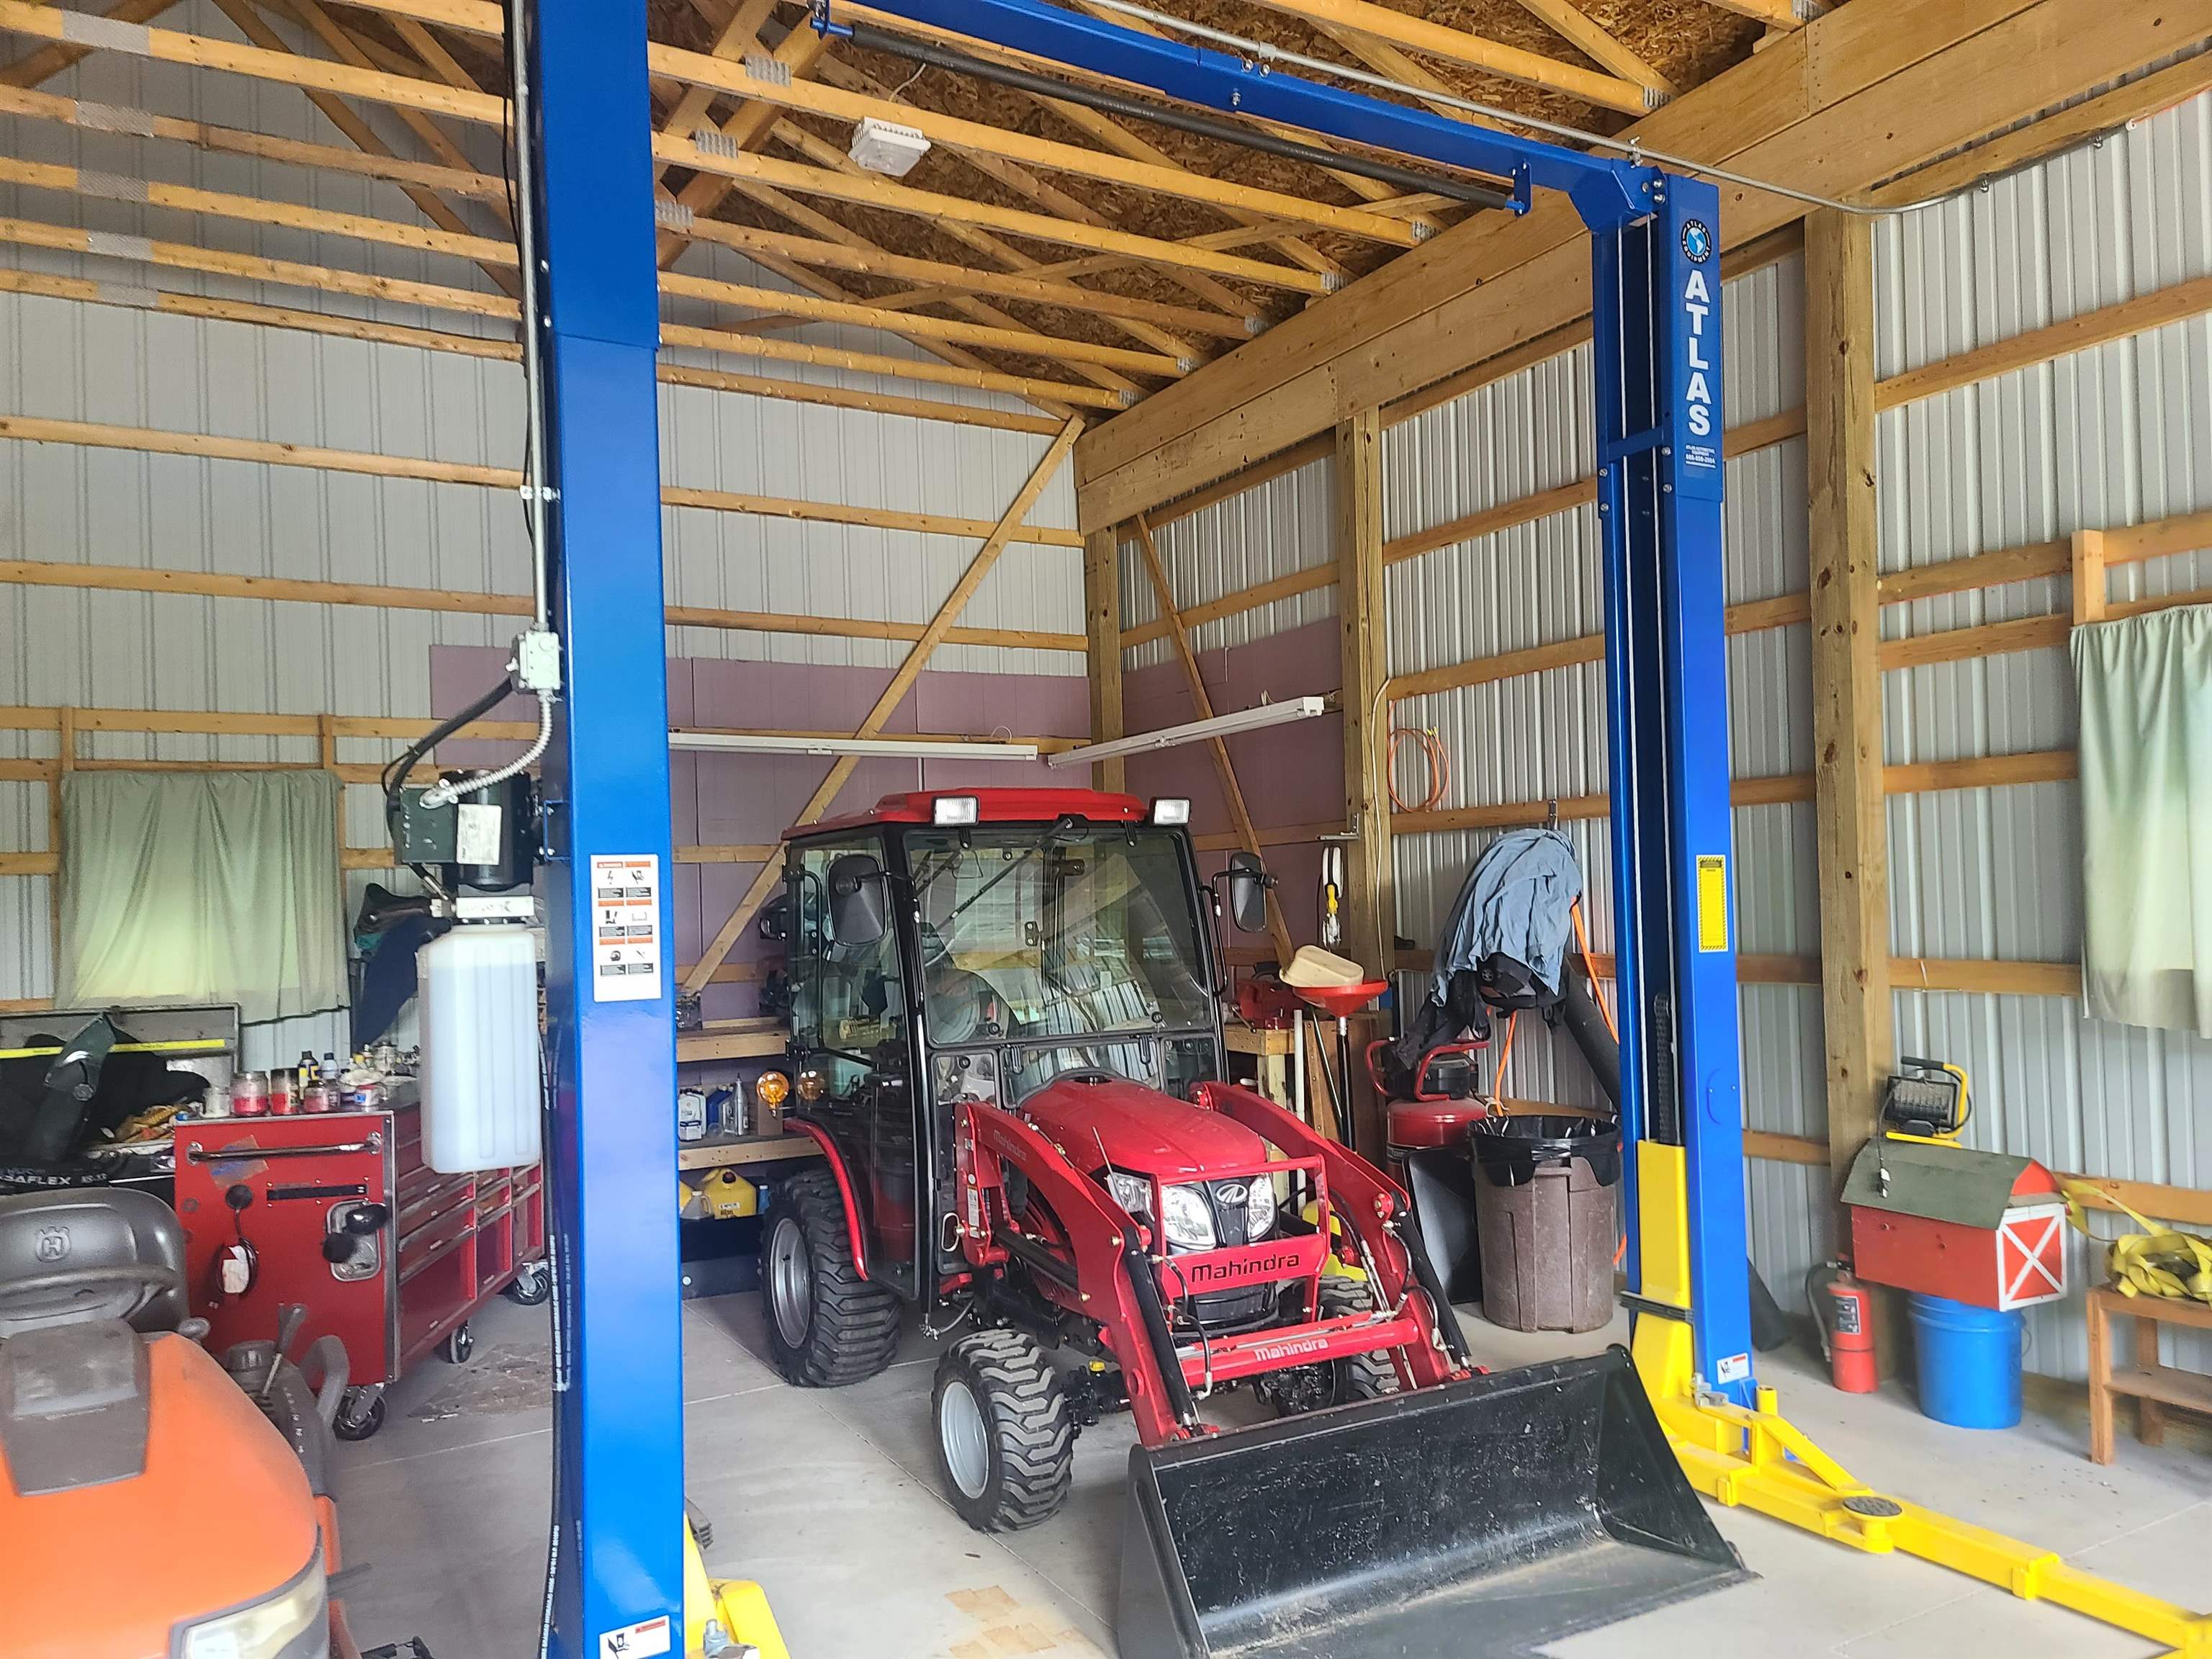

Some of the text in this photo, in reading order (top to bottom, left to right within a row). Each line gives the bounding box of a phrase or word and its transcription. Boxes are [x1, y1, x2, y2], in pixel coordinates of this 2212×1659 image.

[1686, 220, 1707, 233] ATLAS
[1682, 240, 1711, 263] EQUIPMENT
[1685, 269, 1712, 436] ATLAS
[1191, 1254, 1300, 1283] Mahindra
[1253, 1338, 1329, 1362] Mahindra
